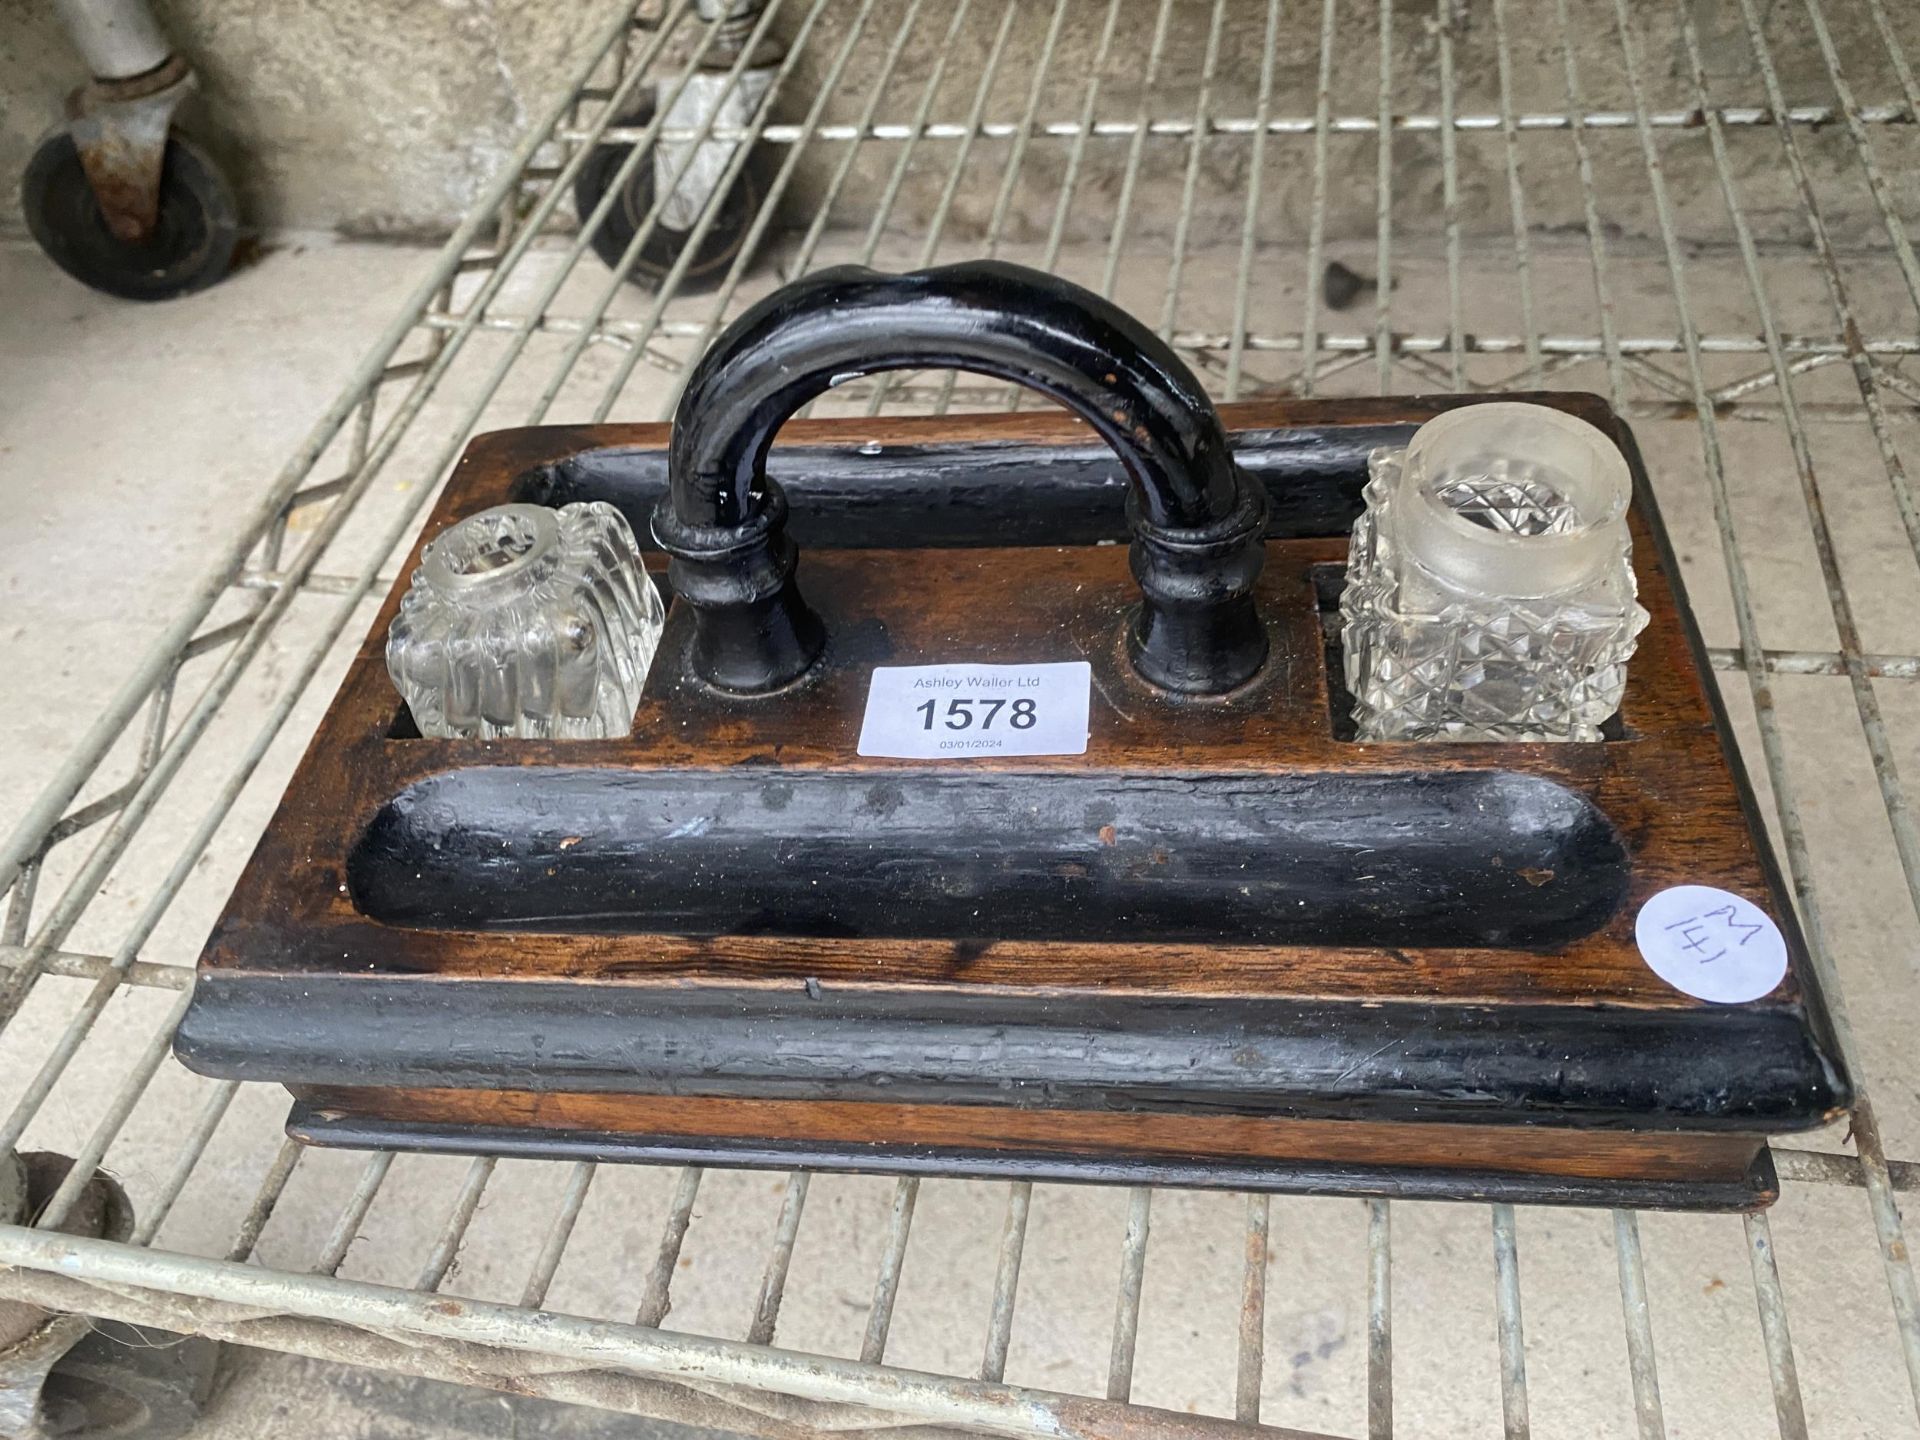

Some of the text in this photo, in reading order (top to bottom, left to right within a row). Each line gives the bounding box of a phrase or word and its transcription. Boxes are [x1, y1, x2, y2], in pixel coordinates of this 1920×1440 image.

[913, 676, 1041, 690] Ashley Waller Ltd
[916, 698, 1037, 730] 1578
[939, 739, 1003, 750] 03/01/2024
